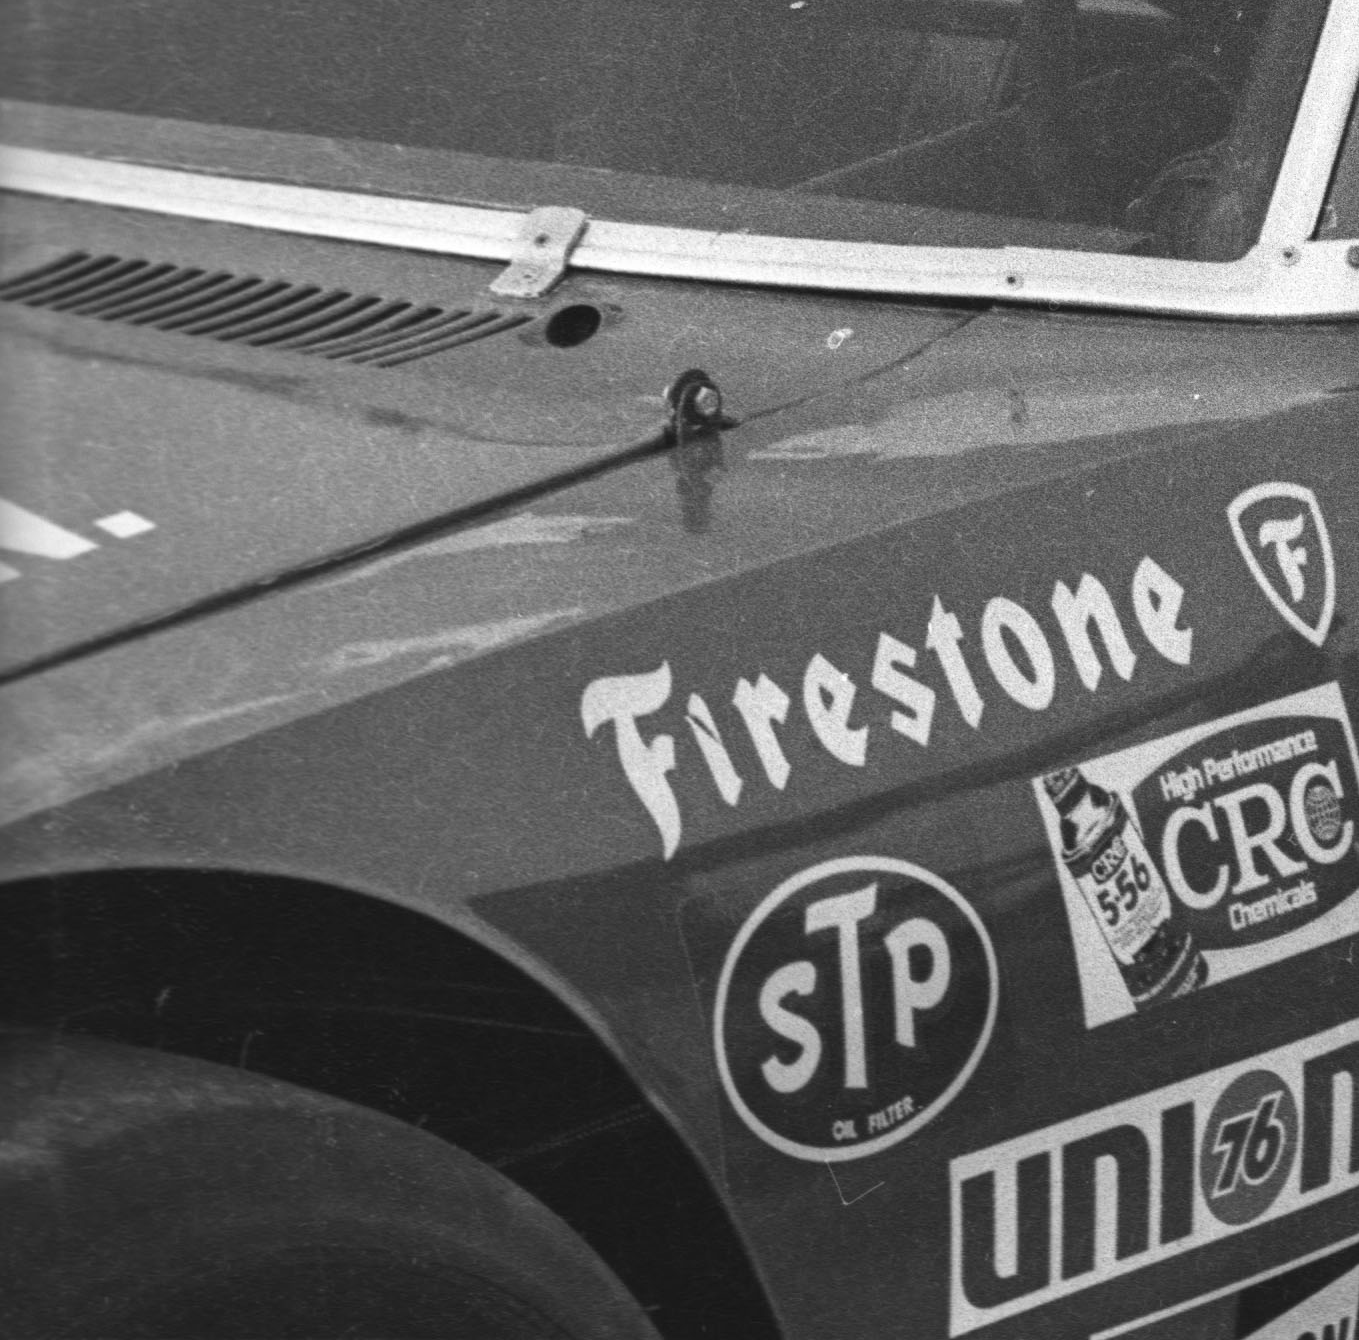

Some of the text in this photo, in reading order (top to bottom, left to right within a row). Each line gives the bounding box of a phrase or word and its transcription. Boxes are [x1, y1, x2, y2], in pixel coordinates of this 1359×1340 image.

[1258, 514, 1308, 604] F
[580, 555, 1194, 861] Firestone
[1159, 729, 1319, 802] High Performance
[1162, 759, 1354, 910] CRC
[1228, 880, 1319, 932] Chemicals
[759, 882, 951, 1094] STP
[832, 1096, 914, 1140] OIL FILTER
[1211, 1089, 1287, 1199] 76
